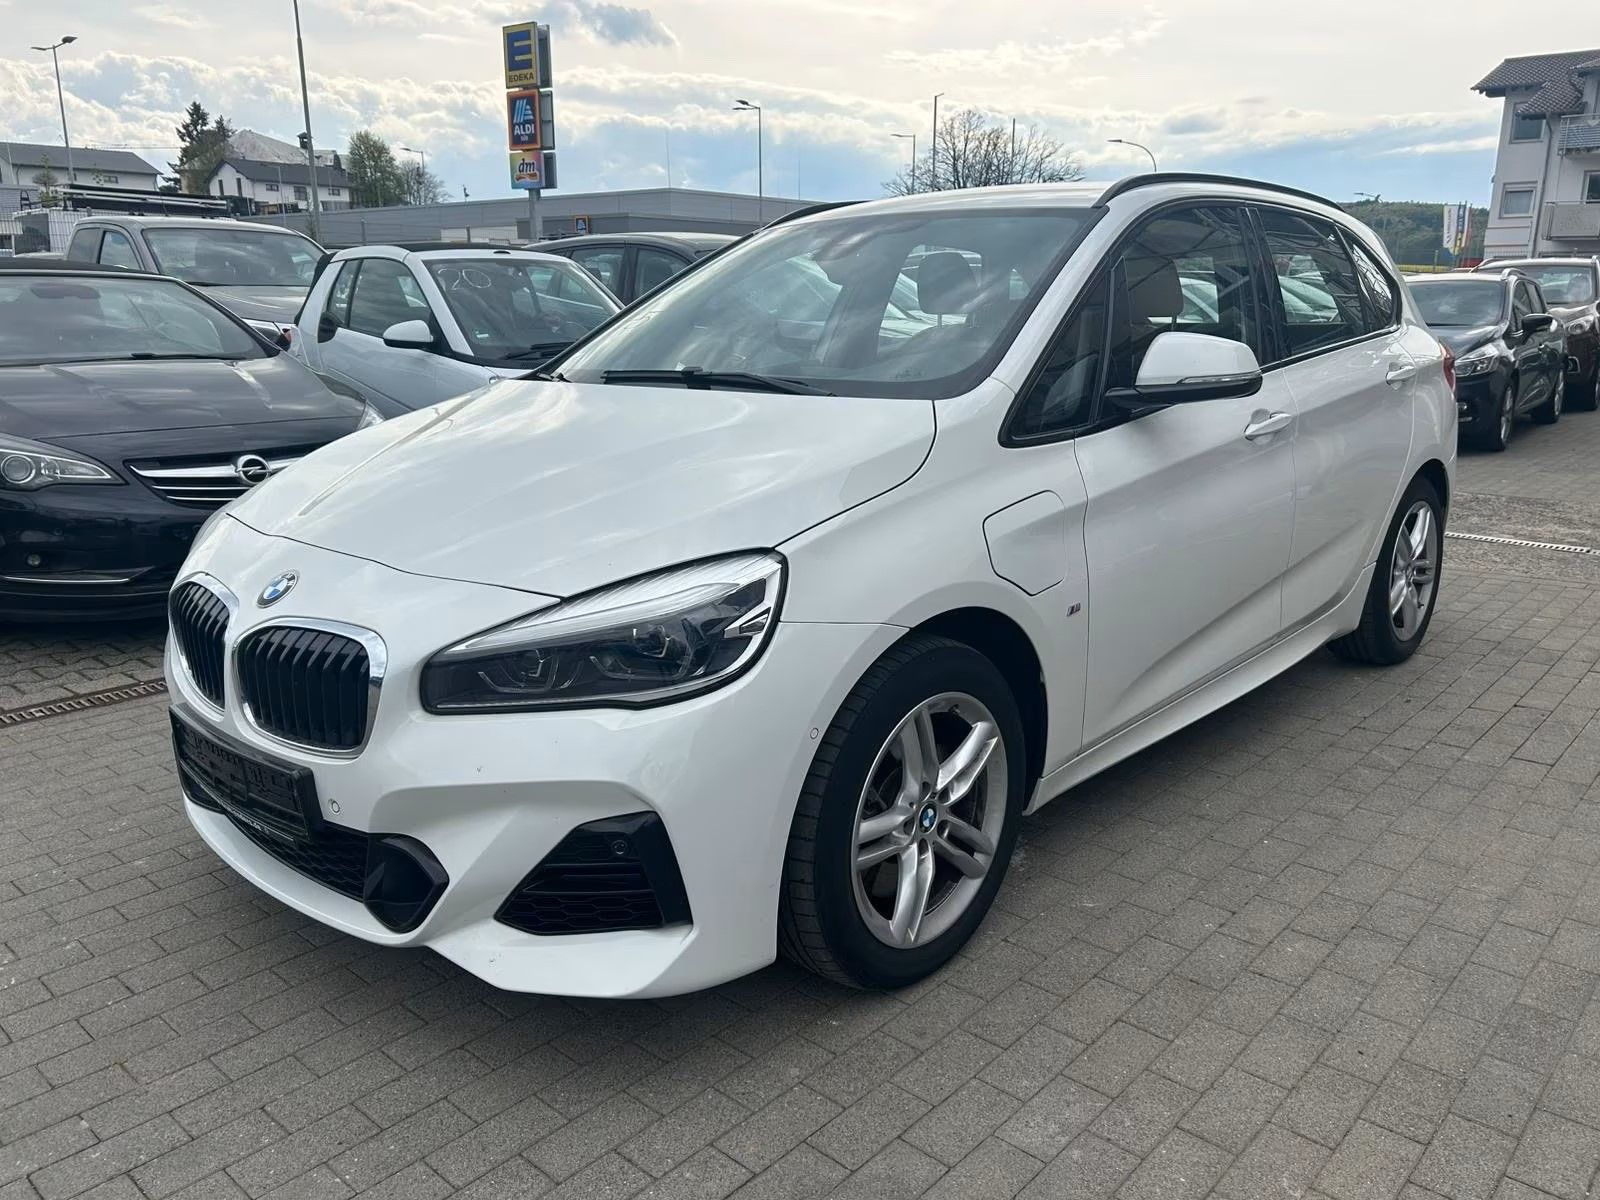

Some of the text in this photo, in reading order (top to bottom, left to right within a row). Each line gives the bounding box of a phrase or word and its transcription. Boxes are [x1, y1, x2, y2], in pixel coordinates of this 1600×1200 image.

[508, 73, 534, 83] EDEKA
[513, 124, 535, 136] ALDI
[518, 158, 535, 173] dm
